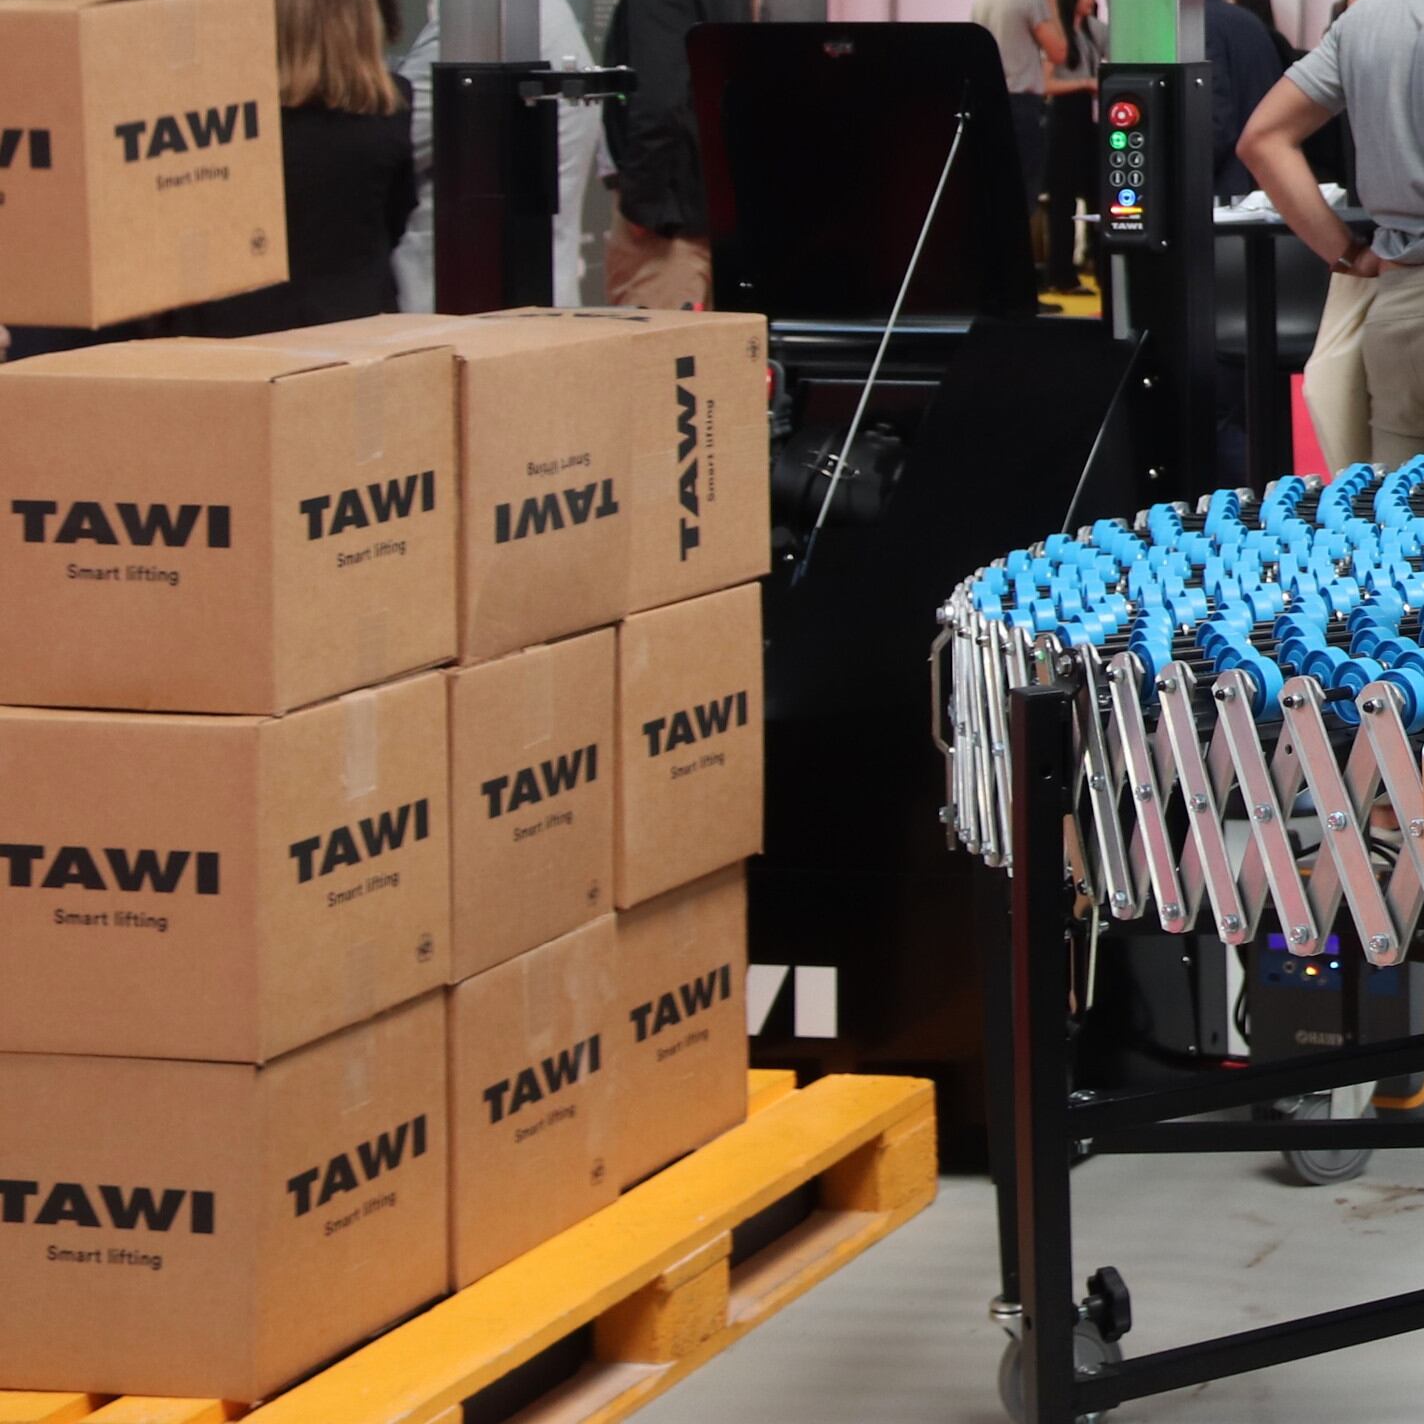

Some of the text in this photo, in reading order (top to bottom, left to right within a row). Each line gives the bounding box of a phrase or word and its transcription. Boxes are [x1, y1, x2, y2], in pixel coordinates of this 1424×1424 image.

[113, 100, 259, 163] TAWI
[156, 165, 230, 192] Smart lifting
[1111, 222, 1144, 230] TAWI
[555, 451, 592, 475] Smart
[677, 355, 698, 563] TAWI
[704, 453, 717, 503] Smart
[11, 500, 231, 549] TAWI
[300, 470, 436, 542] TAWI
[495, 477, 619, 545] TAWI
[67, 563, 180, 586] Smart lifting
[336, 538, 407, 569] Smart lifting
[643, 691, 748, 758] TAWI
[482, 744, 598, 819] TAWI
[669, 758, 698, 780] Smart
[290, 799, 430, 885] TAWI
[512, 809, 574, 843] Smart lifting
[0, 843, 221, 896] TAWI
[327, 869, 400, 909] Smart lifting
[54, 907, 169, 933] Smart lifting
[629, 963, 732, 1043] TAWI
[482, 1033, 601, 1126] TAWI
[514, 1103, 576, 1144] Smart lifting
[287, 1114, 428, 1217] TAWI
[0, 1179, 215, 1235] TAWI
[323, 1190, 397, 1237] Smart lifting
[46, 1245, 163, 1271] Smart lifting
